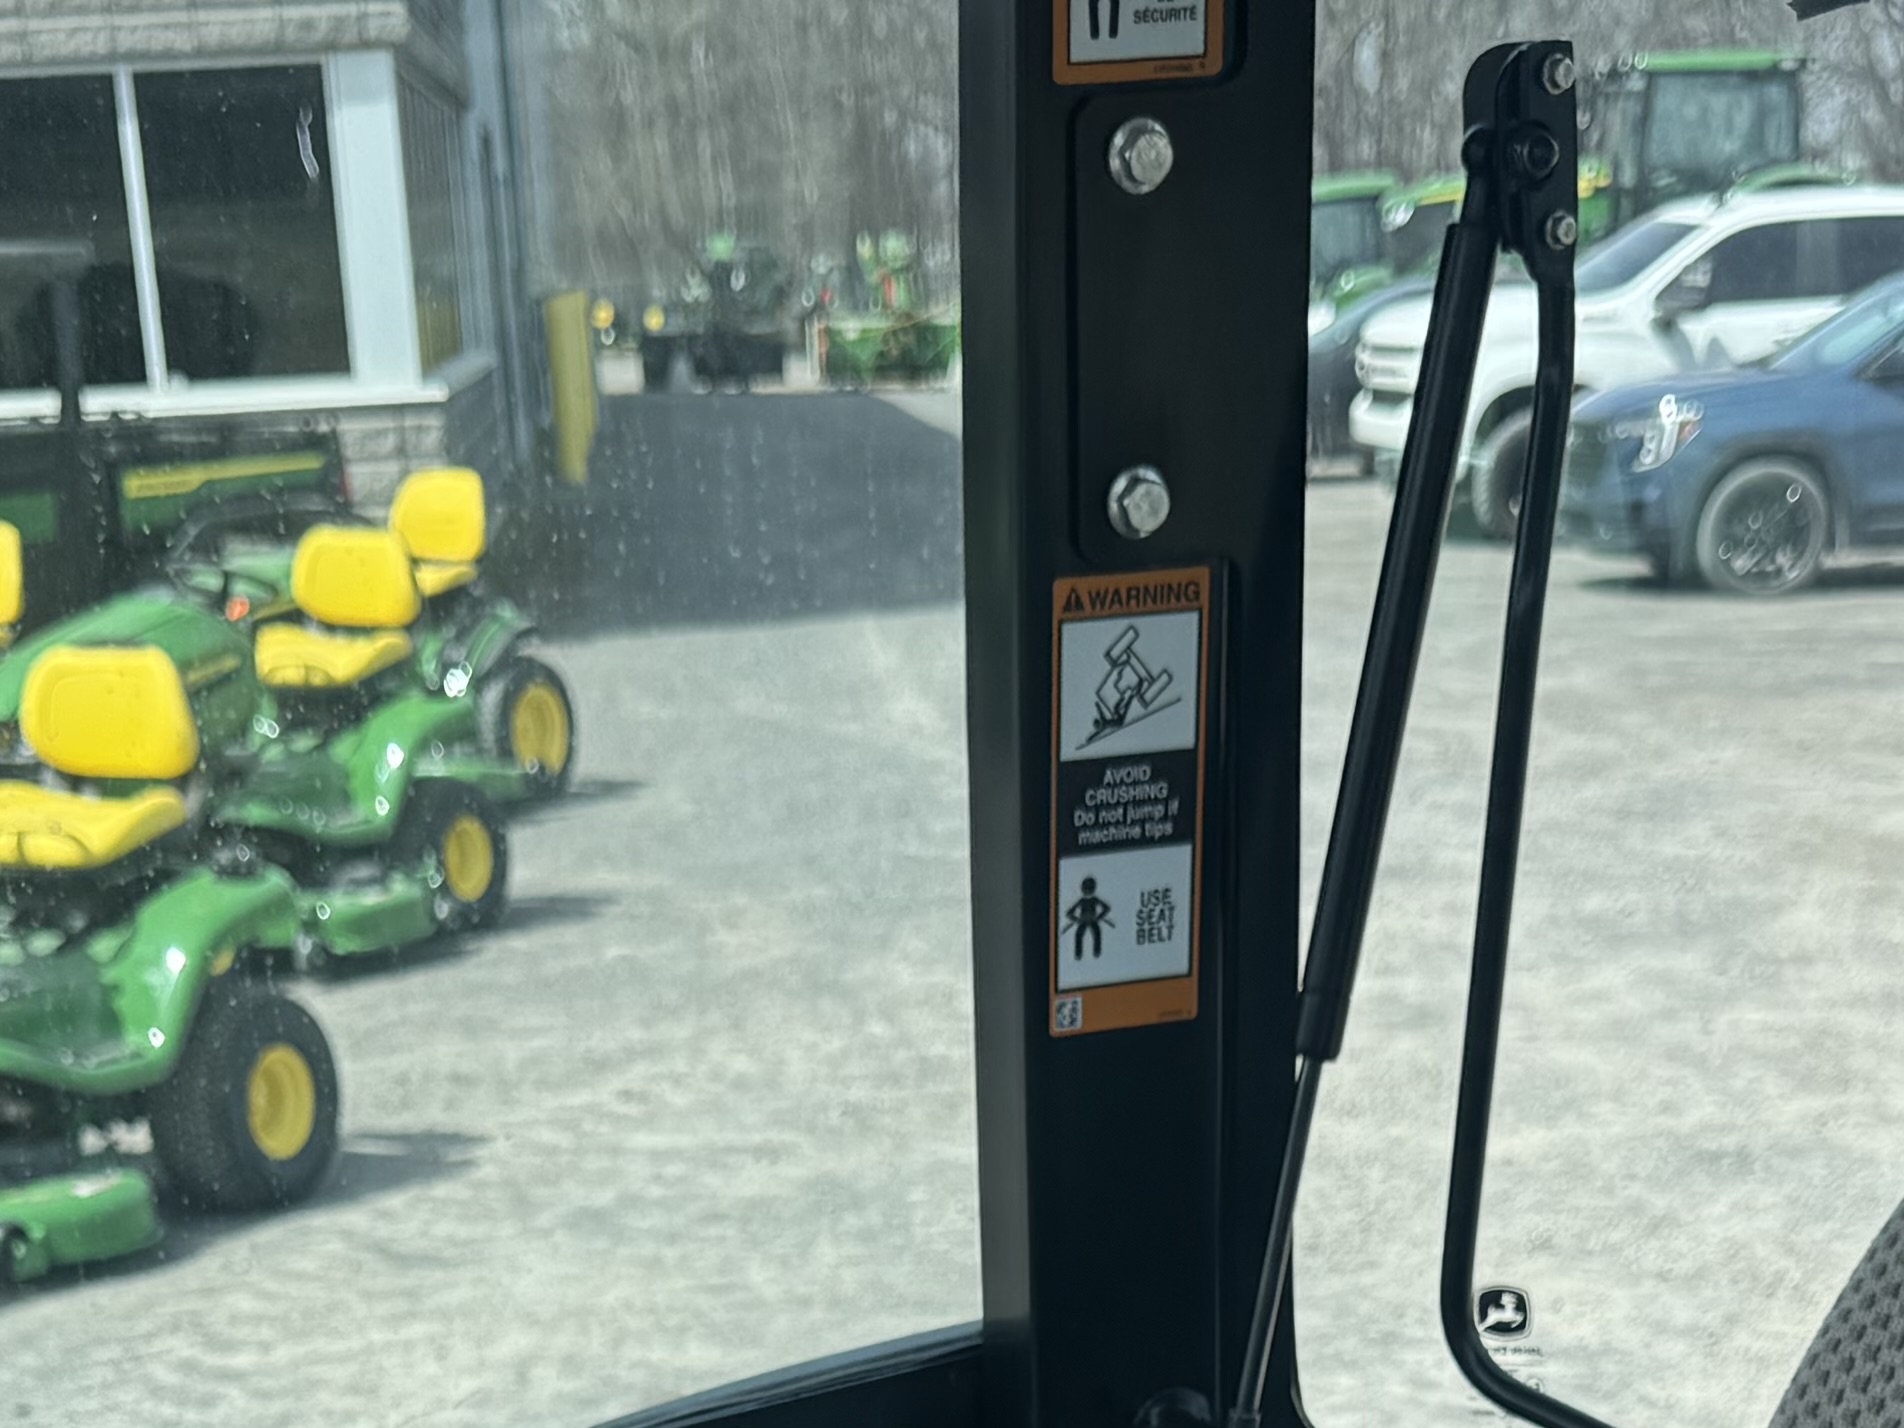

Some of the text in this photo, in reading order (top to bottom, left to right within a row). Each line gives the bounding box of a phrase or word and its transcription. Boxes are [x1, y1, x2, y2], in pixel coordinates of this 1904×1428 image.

[1133, 4, 1197, 25] SÉCURITÉ
[1088, 580, 1201, 611] WARNING
[1103, 765, 1152, 785] AVOID
[1085, 781, 1168, 807] CRUSHING
[1073, 797, 1179, 827] Do not jump if
[1078, 822, 1174, 845] machine tips
[1140, 888, 1172, 908] USE
[1135, 905, 1175, 928] SEAT
[1135, 924, 1175, 945] BELT
